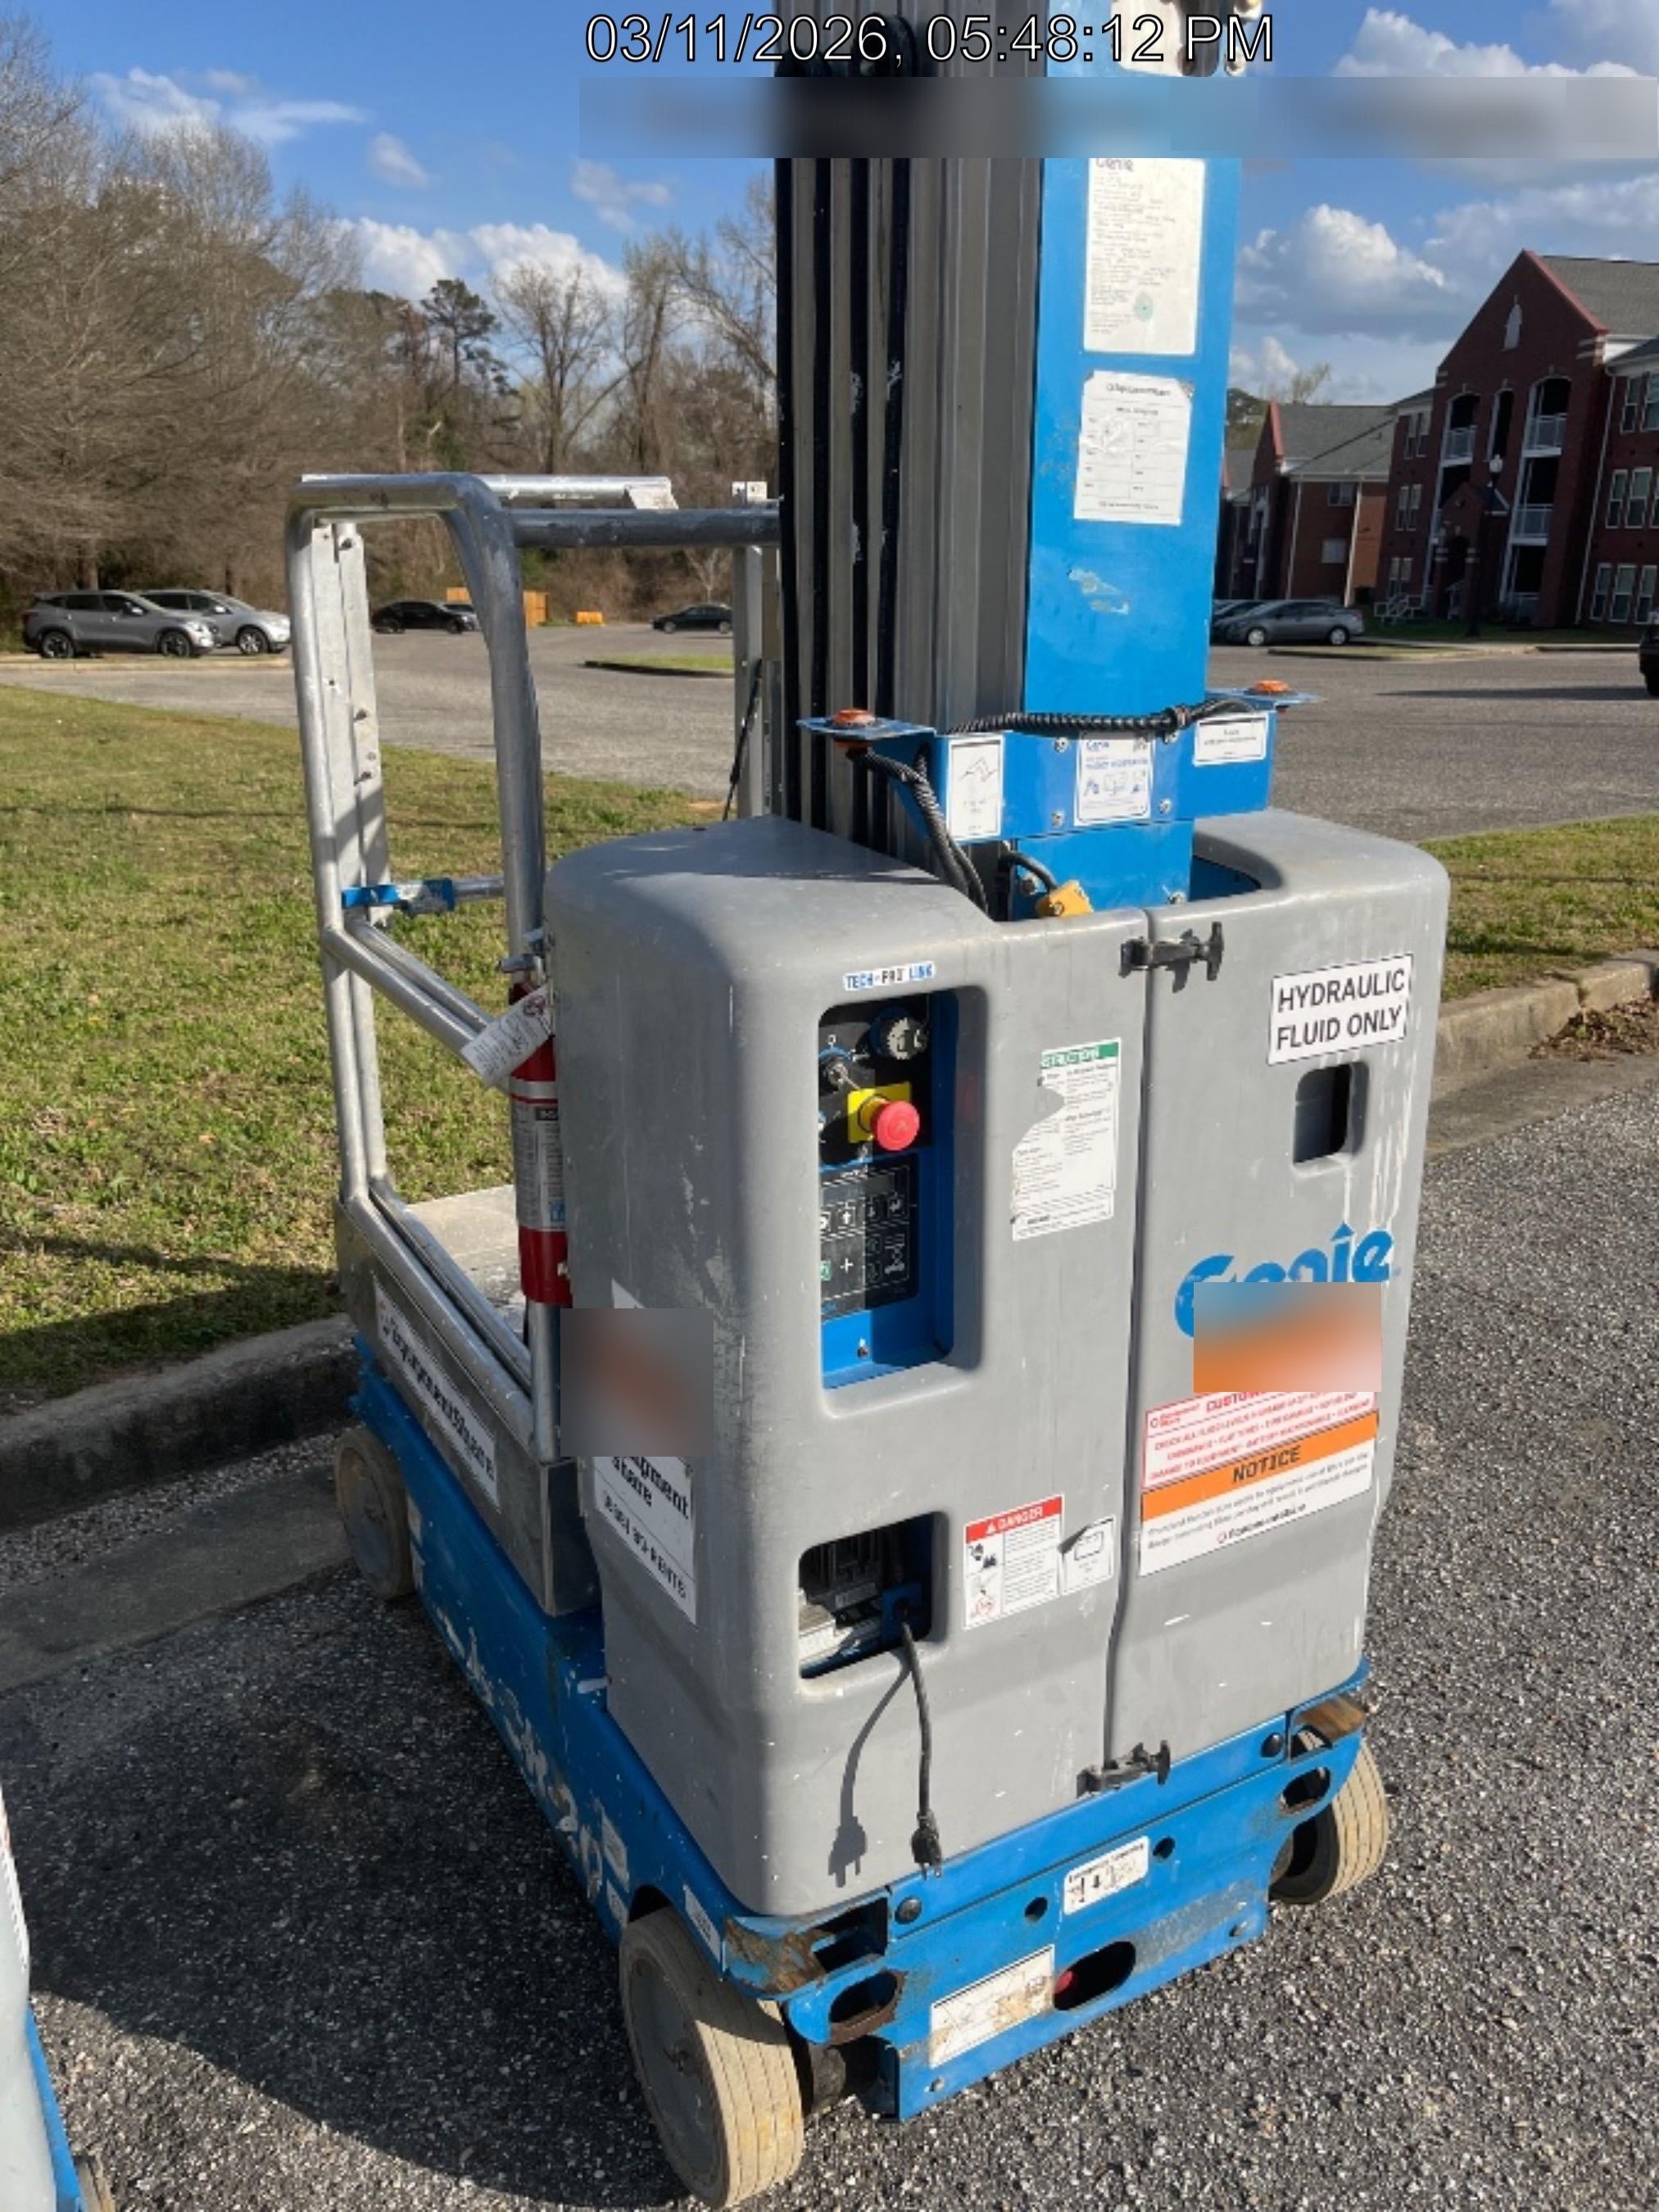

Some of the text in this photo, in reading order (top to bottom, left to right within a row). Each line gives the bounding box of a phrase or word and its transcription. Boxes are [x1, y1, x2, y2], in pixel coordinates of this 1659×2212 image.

[1277, 968, 1405, 1013] HYDRAULIC
[1276, 1004, 1403, 1051] FLUID ONLY
[1232, 1445, 1301, 1483] NOTICE
[998, 1506, 1043, 1529] DANGER
